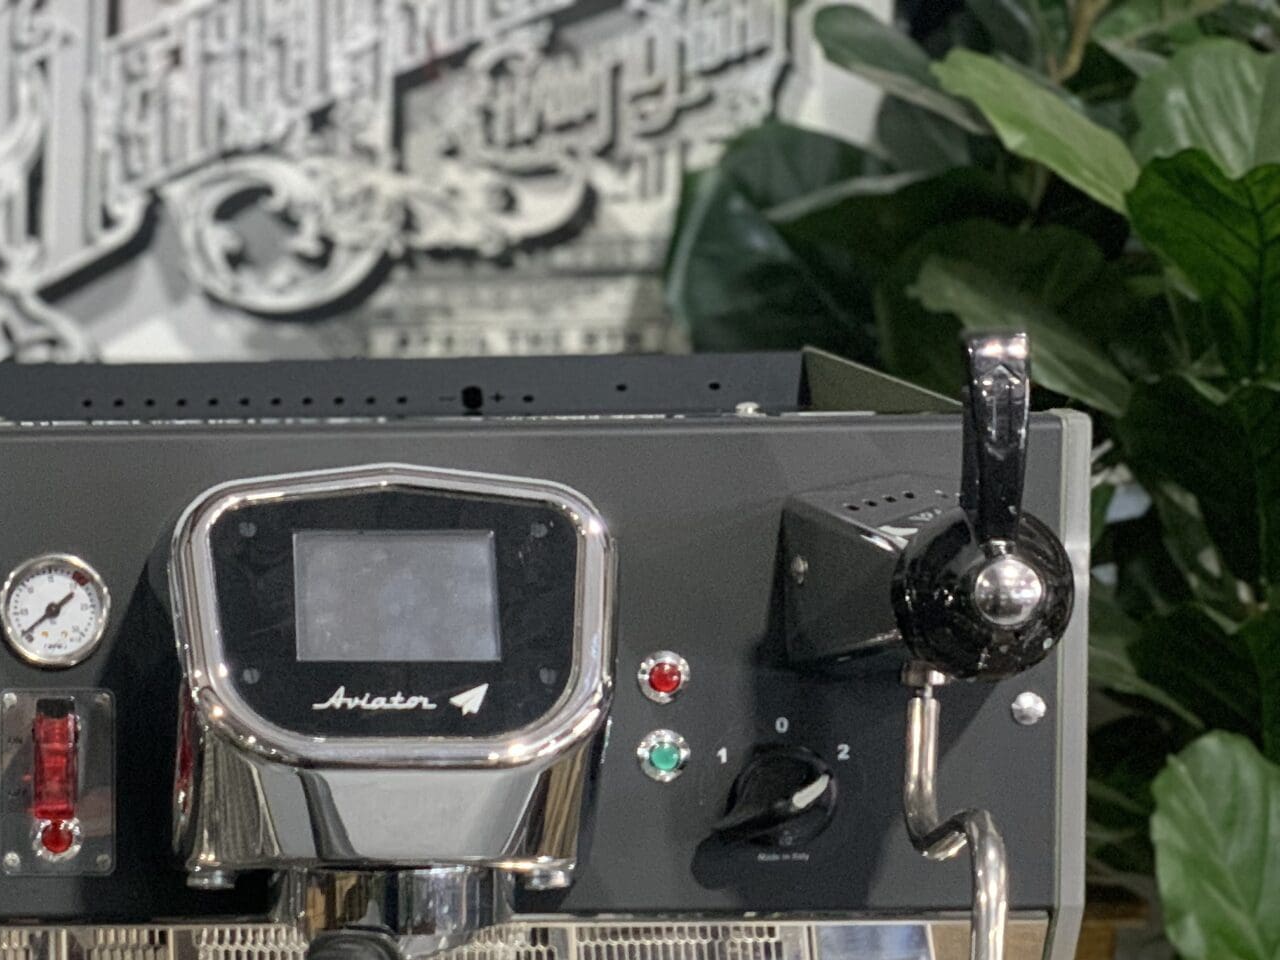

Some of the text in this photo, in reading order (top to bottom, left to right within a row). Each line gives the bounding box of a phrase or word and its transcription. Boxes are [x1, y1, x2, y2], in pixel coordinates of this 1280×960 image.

[312, 685, 437, 710] Aviator
[775, 716, 789, 734] 0
[716, 746, 728, 764] 1
[837, 743, 851, 761] 2
